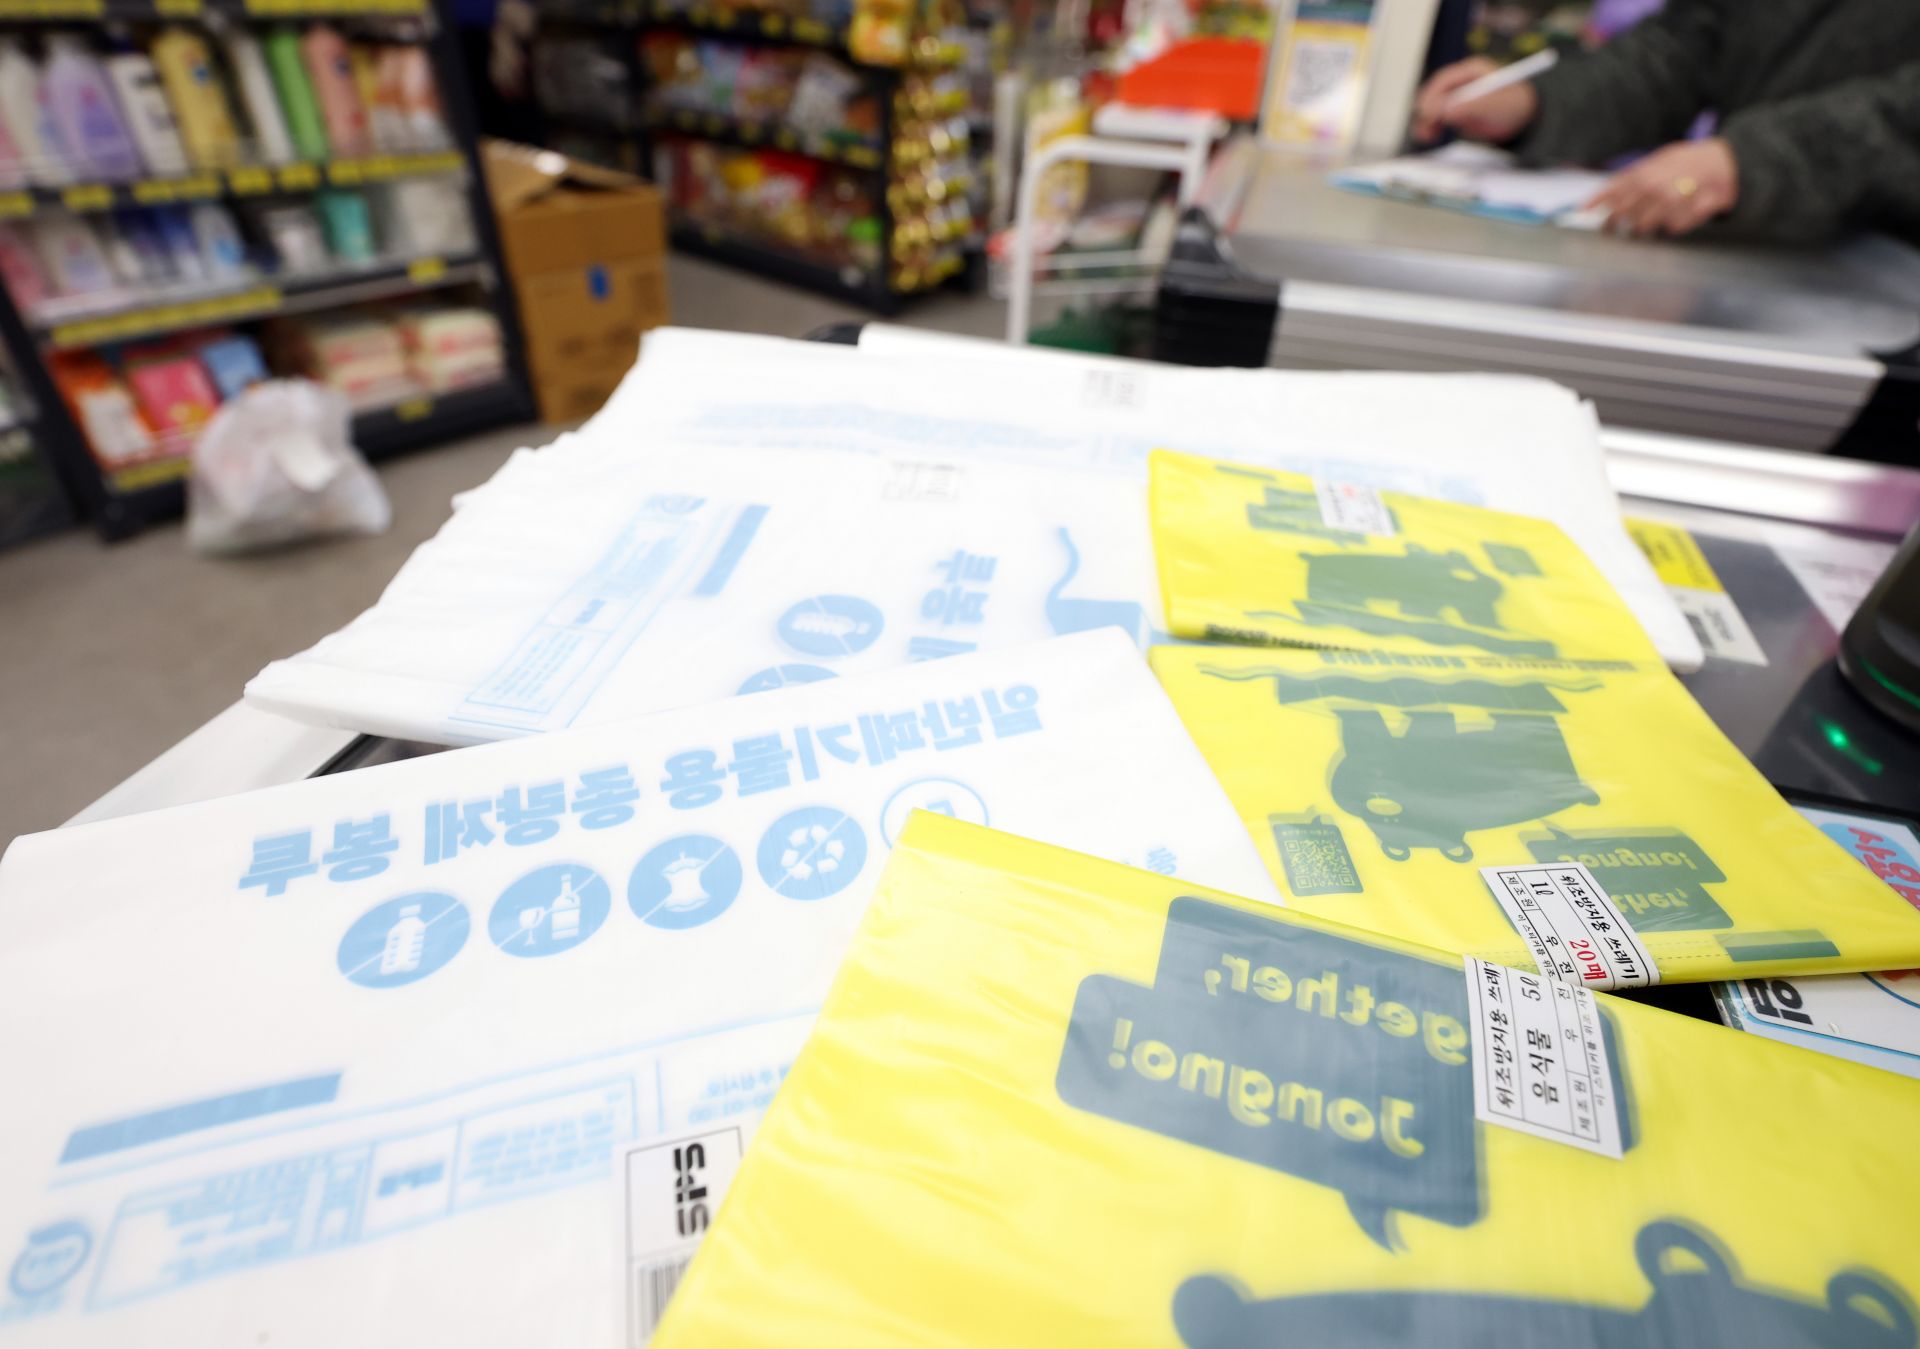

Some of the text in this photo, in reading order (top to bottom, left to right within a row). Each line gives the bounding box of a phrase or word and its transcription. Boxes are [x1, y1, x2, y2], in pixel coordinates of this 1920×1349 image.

[1560, 875, 1640, 979] 위조방지용 쓰레기
[1569, 939, 1608, 981] 20매
[1526, 1028, 1560, 1105] 음식물
